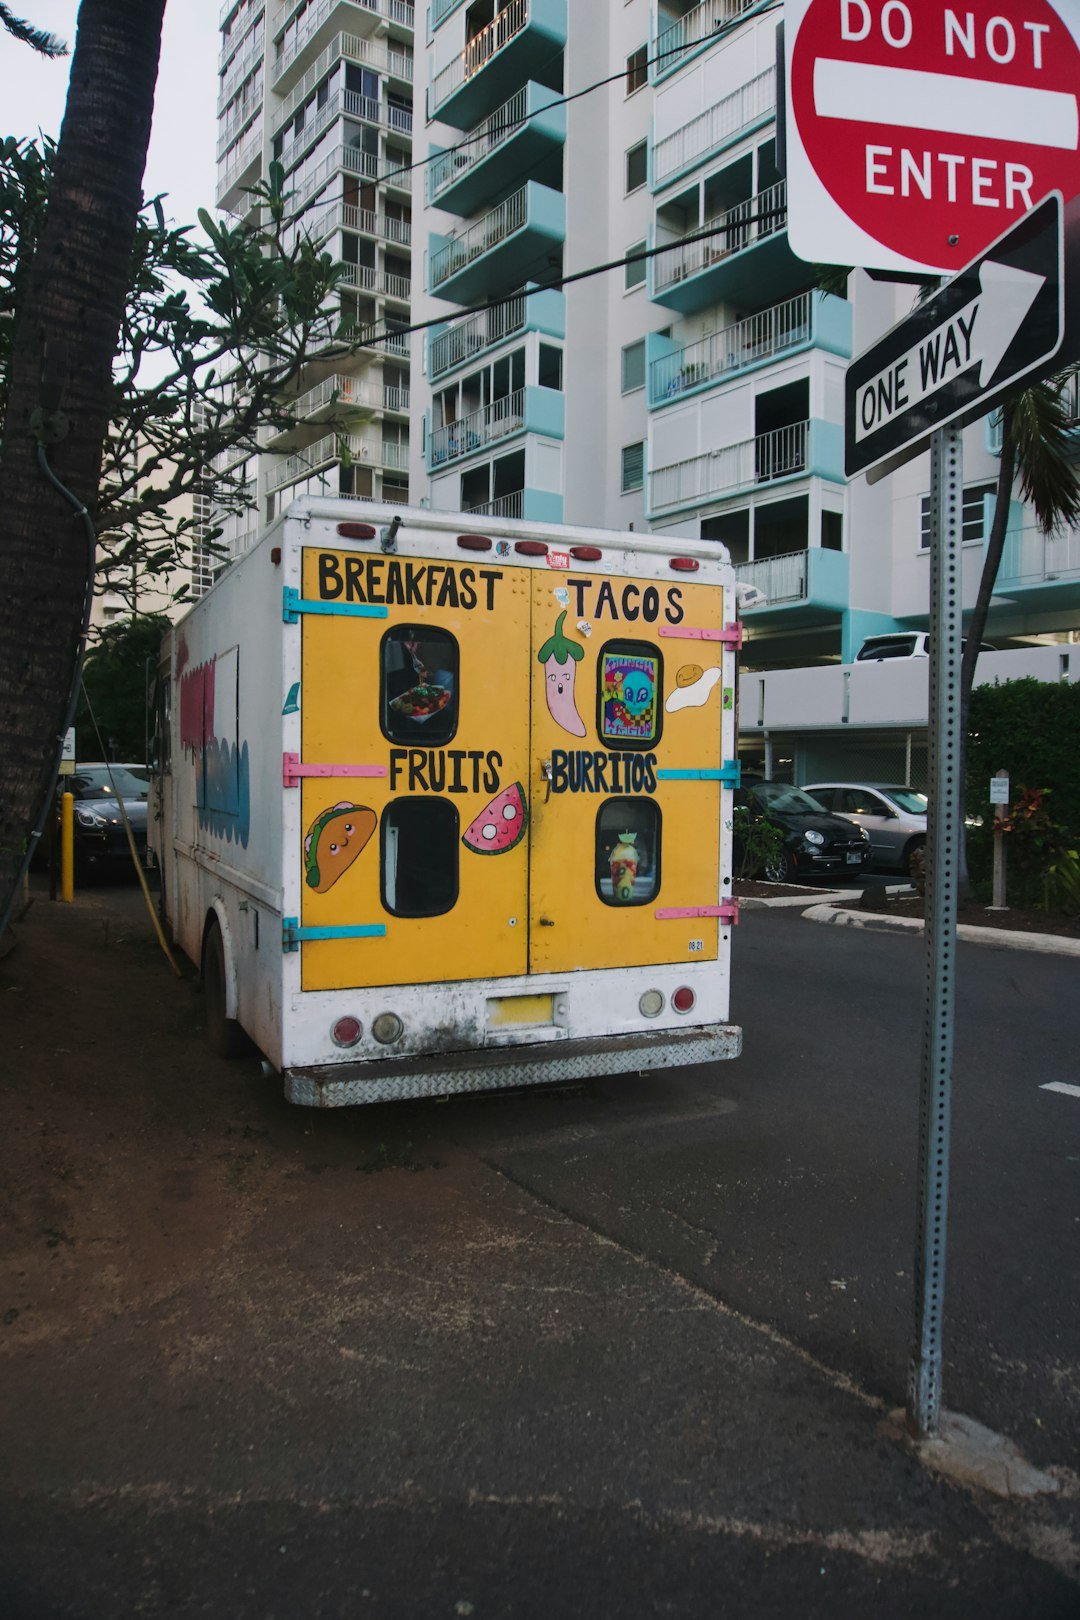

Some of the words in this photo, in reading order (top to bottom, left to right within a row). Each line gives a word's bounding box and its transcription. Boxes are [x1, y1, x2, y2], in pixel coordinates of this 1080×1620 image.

[840, 0, 913, 49] DO
[944, 8, 1050, 69] NOT
[865, 144, 1034, 211] ENTER
[861, 358, 909, 432] ONE
[919, 303, 979, 393] WAY
[318, 553, 503, 611] BREAKFAST
[567, 578, 684, 625] TACOS
[389, 749, 503, 794] FRUITS
[550, 748, 658, 794] BURRITOS
